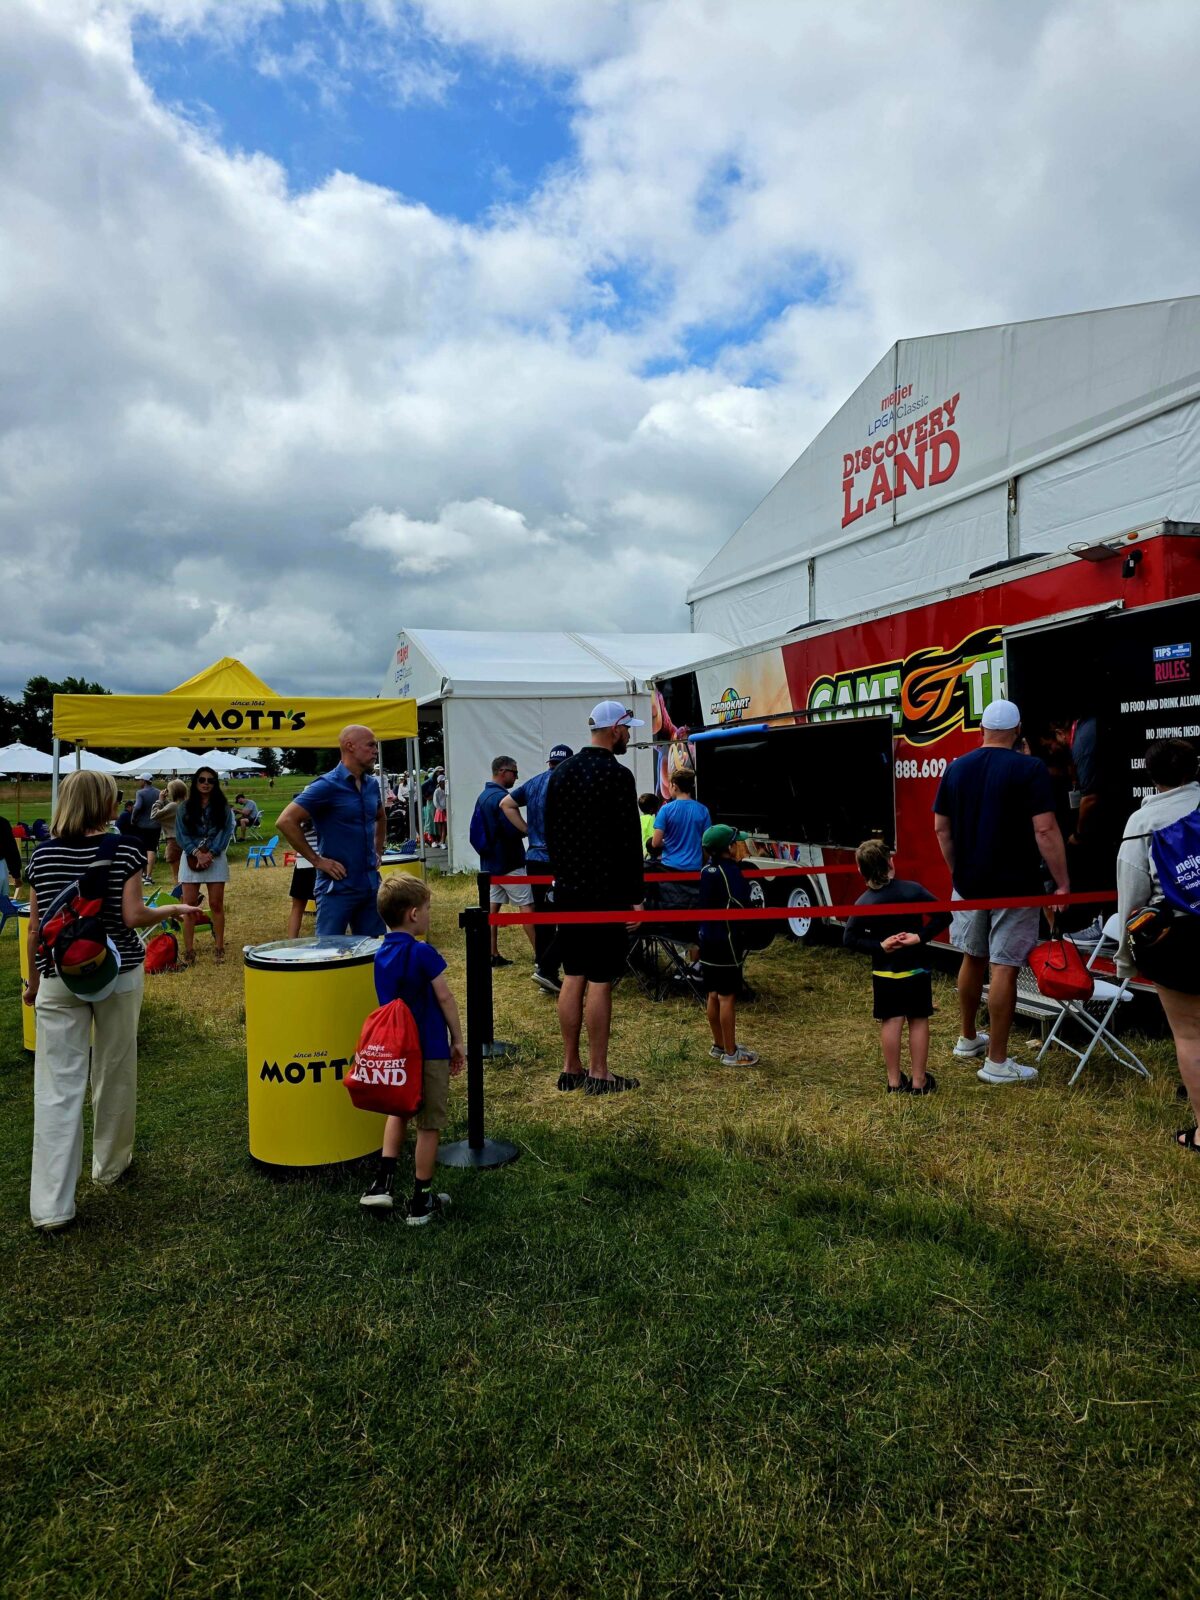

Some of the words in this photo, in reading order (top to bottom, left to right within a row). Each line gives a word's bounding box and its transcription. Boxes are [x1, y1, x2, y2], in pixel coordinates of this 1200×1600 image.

[881, 383, 913, 411] meijer
[843, 392, 960, 480] DISCOVERY
[842, 429, 960, 529] LAND
[1155, 647, 1171, 658] TIPS
[1155, 660, 1190, 682] RULES:
[812, 674, 900, 725] GAME
[1120, 702, 1130, 713] NO
[1130, 700, 1145, 712] FOOD
[1146, 699, 1159, 711] AND
[1159, 697, 1179, 709] DRINK
[187, 708, 306, 730] MOTT'S
[1145, 729, 1155, 740] NO
[1156, 727, 1182, 739] JUMPING
[895, 757, 949, 779] 888.609
[1131, 758, 1147, 769] LEAV
[1133, 787, 1142, 797] DO
